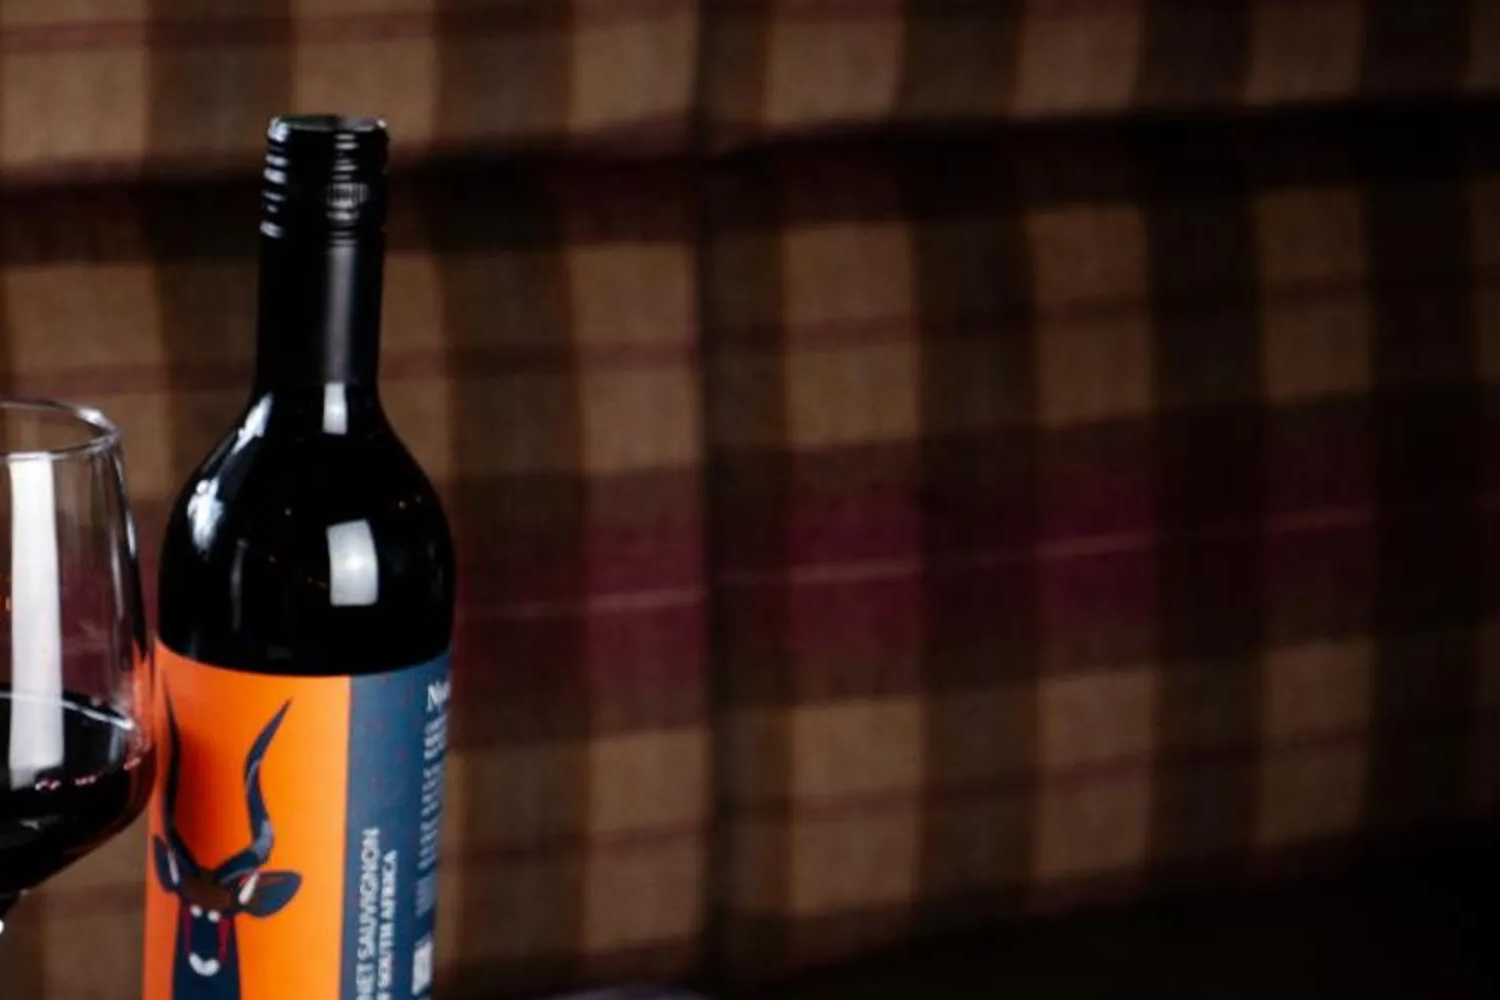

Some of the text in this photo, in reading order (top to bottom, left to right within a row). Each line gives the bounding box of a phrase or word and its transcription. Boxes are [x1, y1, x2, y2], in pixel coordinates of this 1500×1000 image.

[357, 827, 380, 960] SAUVIGNON
[381, 850, 398, 920] AFRICA
[378, 922, 394, 989] SOUTH
